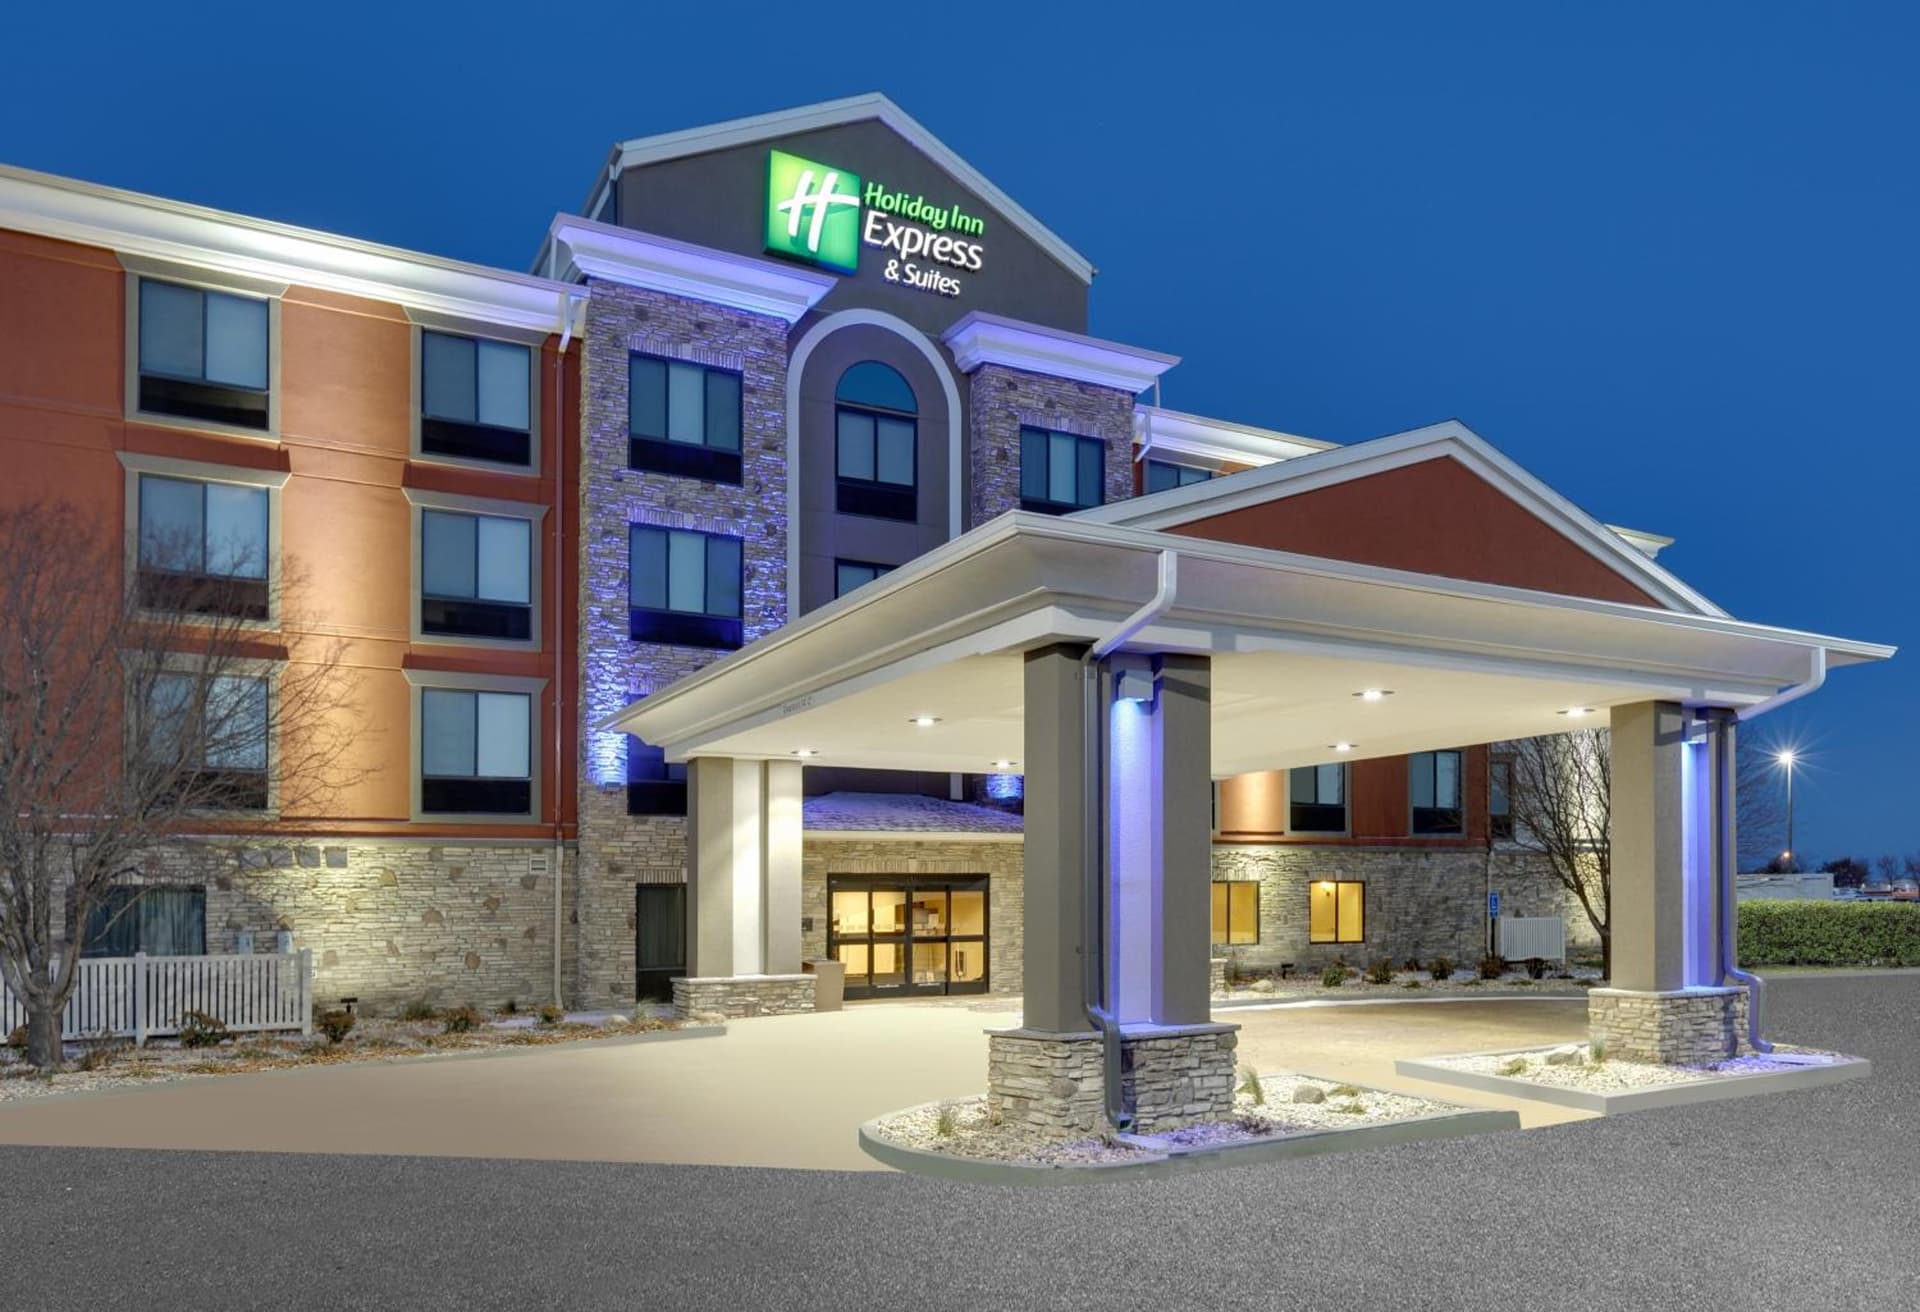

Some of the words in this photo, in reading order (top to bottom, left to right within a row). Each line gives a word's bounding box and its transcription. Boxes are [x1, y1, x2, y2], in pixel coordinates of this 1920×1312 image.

[864, 182, 948, 230] Holiday
[951, 205, 984, 235] Inn
[864, 210, 984, 270] Express
[884, 259, 900, 281] &
[903, 263, 961, 295] Suites
